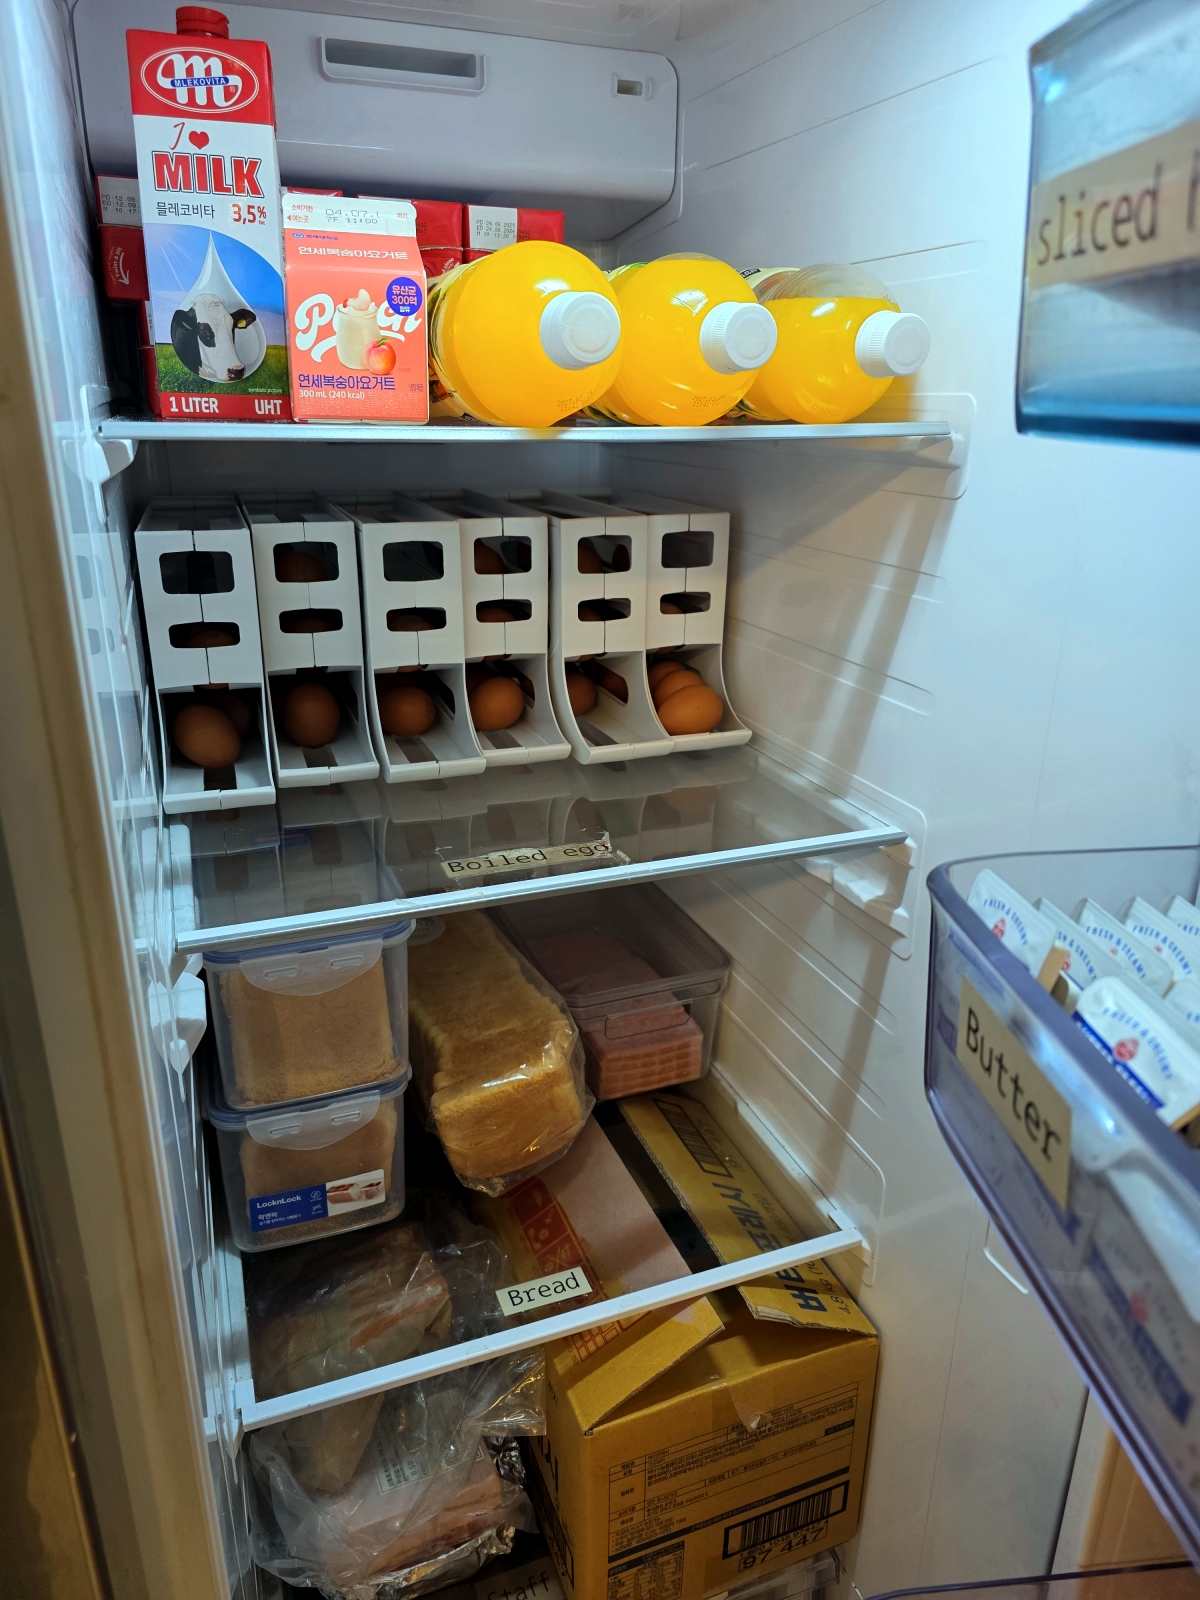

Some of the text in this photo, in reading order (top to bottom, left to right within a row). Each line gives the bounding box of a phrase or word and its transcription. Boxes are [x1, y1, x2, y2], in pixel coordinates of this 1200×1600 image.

[174, 77, 227, 88] MLEKOVITA
[152, 151, 265, 198] MILK
[101, 193, 139, 203] PD:12.08.
[102, 199, 140, 209] ED:12.08.
[156, 201, 215, 219] 믈레코비타
[232, 203, 267, 225] 3,5%
[291, 204, 313, 213] 소비기한
[1036, 157, 1165, 267] sliced
[298, 246, 409, 260] 연세복숭아요거트
[392, 285, 416, 296] 유산균
[391, 295, 418, 306] 300억
[298, 373, 396, 391] 연세복숭아요거트
[299, 390, 365, 400] 300 mL (240 kcal)
[169, 396, 219, 413] 1 LITER
[254, 398, 283, 415] UHT
[447, 840, 610, 873] Boiled egg
[1085, 925, 1115, 942] FRESH
[1132, 924, 1161, 940] FRESH
[965, 1006, 1062, 1164] Butter
[256, 1195, 303, 1210] LocknLock
[507, 1271, 581, 1307] Bread
[829, 1295, 852, 1315] 4.8
[742, 1527, 825, 1569] 97 447
